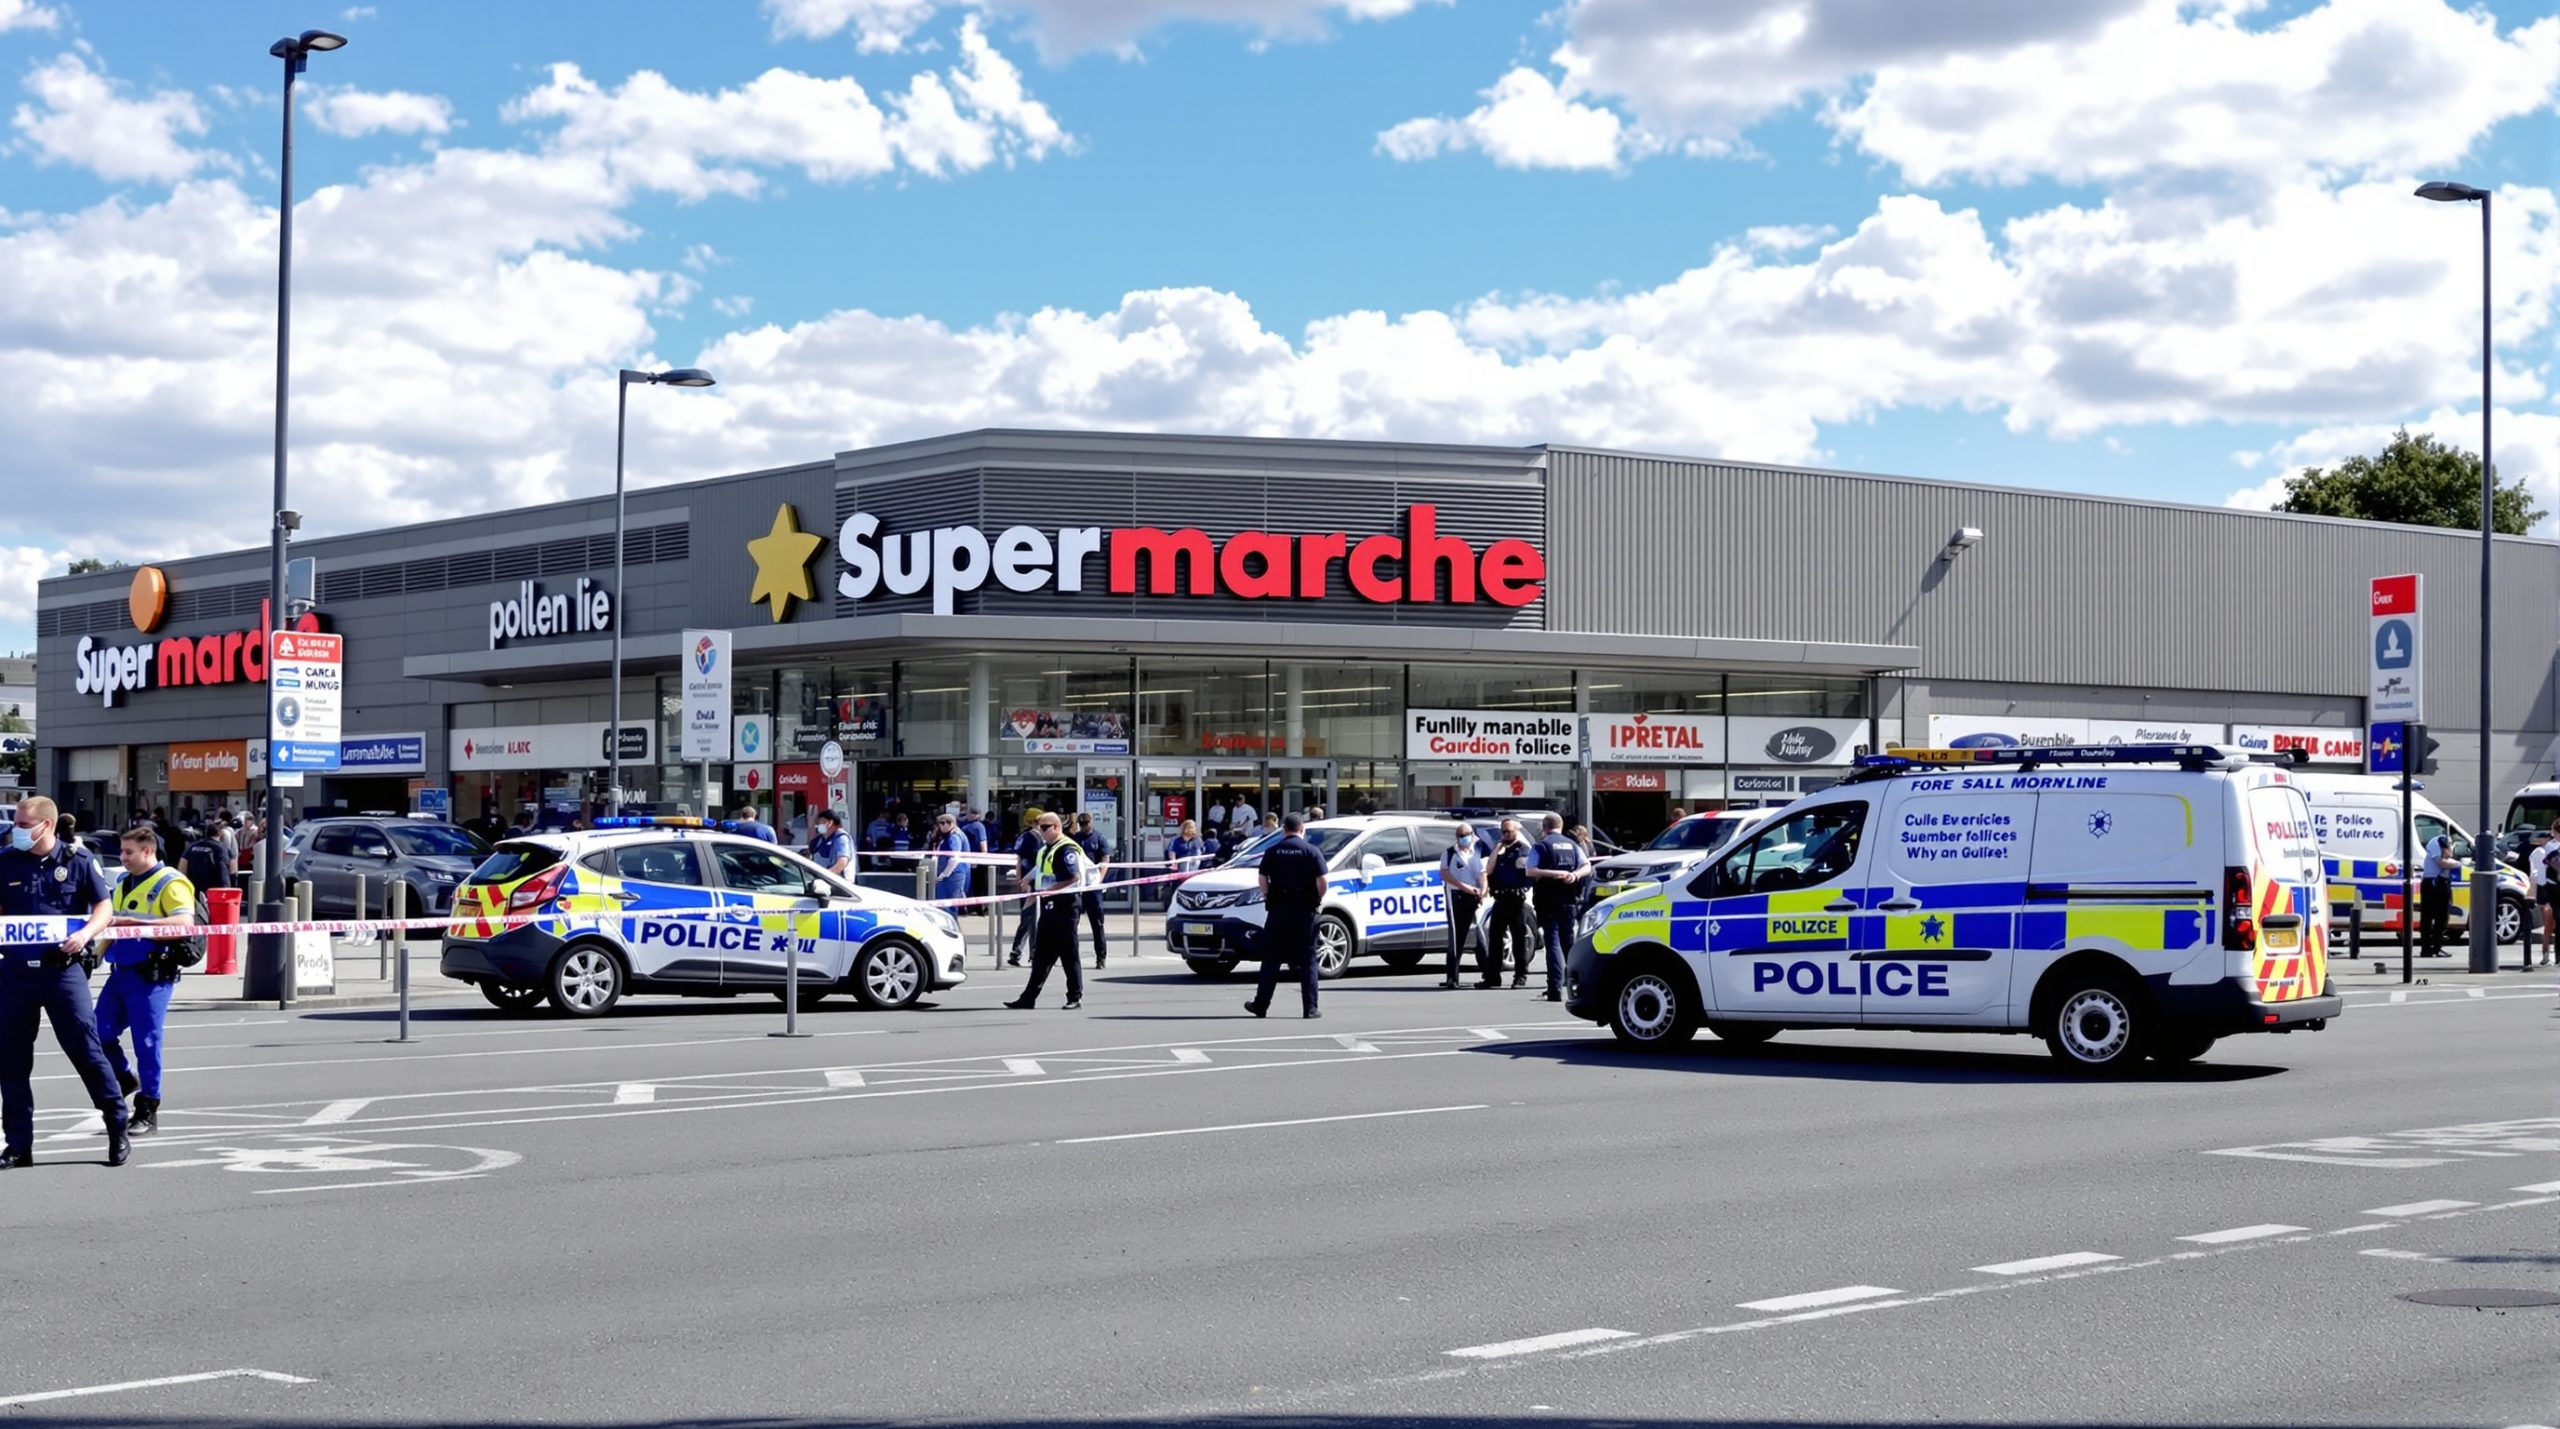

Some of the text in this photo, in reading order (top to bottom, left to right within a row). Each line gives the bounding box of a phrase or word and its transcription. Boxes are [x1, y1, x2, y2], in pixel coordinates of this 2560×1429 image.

[577, 577, 609, 631] lie
[1911, 777, 2108, 791] FORE SALL MORNLINE
[1907, 847, 1937, 860] Why
[1370, 892, 1445, 916] POLICE
[641, 920, 761, 951] POLICE
[1772, 920, 1837, 934] POLIZCE
[1753, 961, 1950, 997] POLICE
